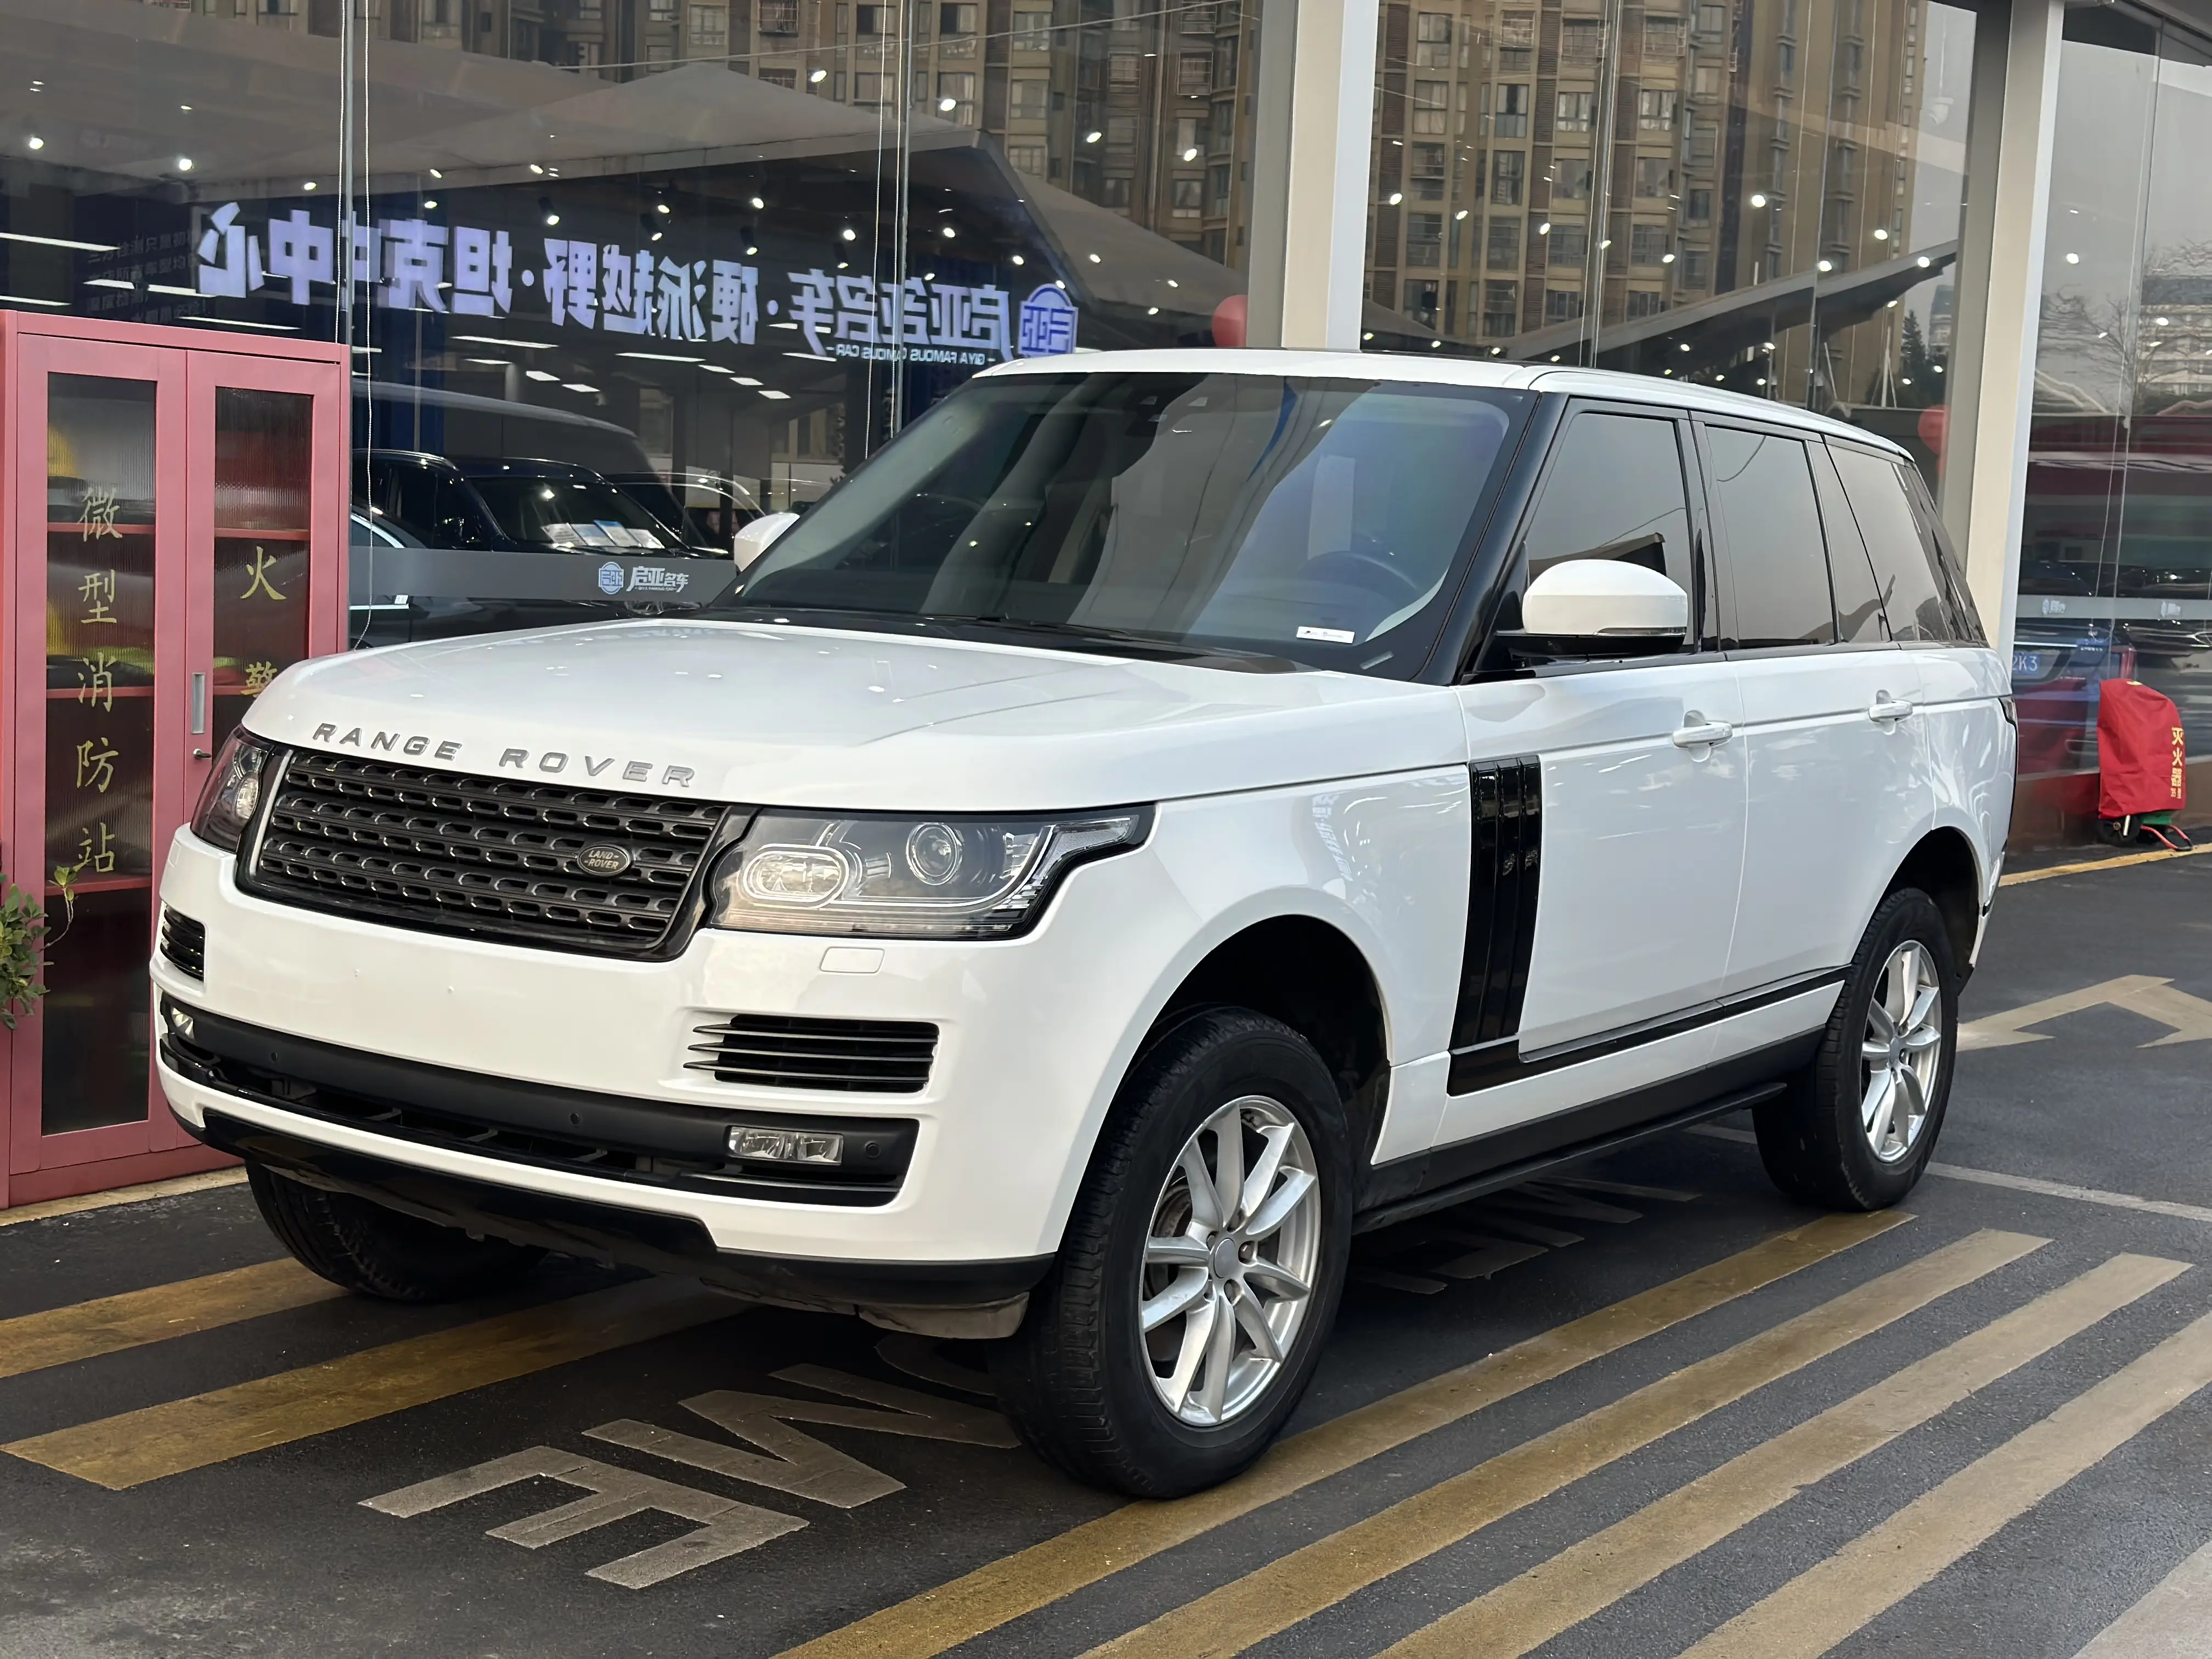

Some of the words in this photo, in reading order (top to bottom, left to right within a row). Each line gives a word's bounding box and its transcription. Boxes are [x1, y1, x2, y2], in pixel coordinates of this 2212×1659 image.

[626, 566, 689, 592] 启亚名车
[74, 486, 123, 873] 微型消防站
[312, 723, 462, 761] RANGE
[499, 747, 696, 788] ROVER
